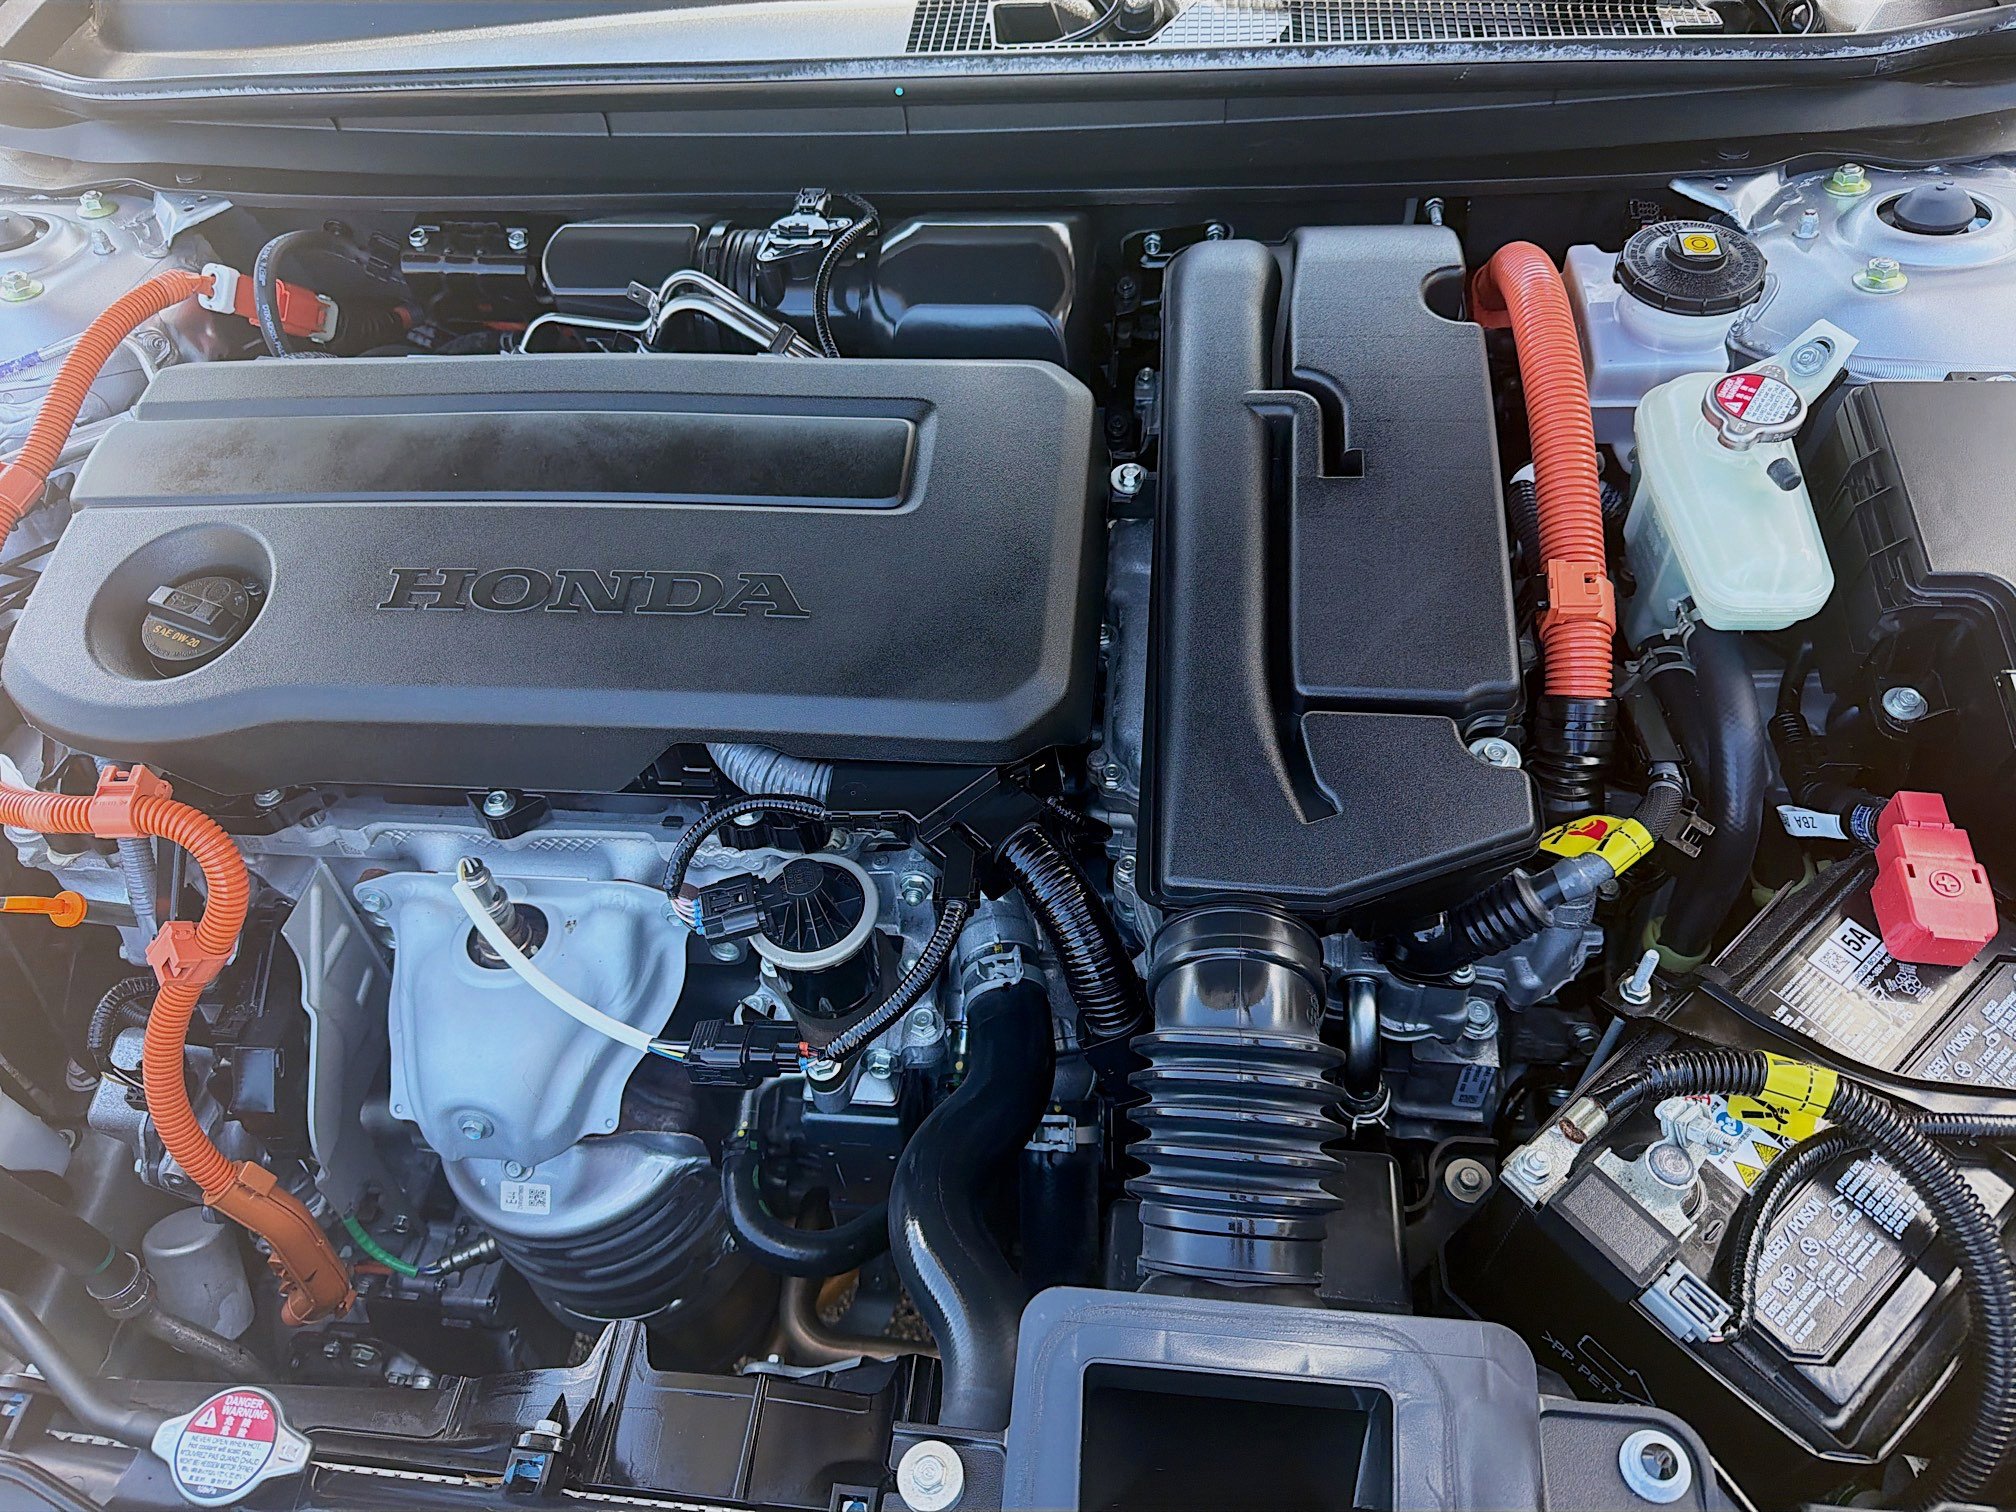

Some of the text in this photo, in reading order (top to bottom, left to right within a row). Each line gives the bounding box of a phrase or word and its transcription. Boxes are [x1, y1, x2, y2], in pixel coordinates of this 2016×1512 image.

[376, 566, 811, 619] HONDA
[153, 625, 173, 638] SAE
[171, 631, 201, 648] 0W-20
[1840, 927, 1872, 952] 5A
[1851, 964, 1869, 982] GROUP
[1875, 949, 1882, 957] 51
[221, 1405, 270, 1420] WARNUNG
[225, 1395, 265, 1408] DANGER
